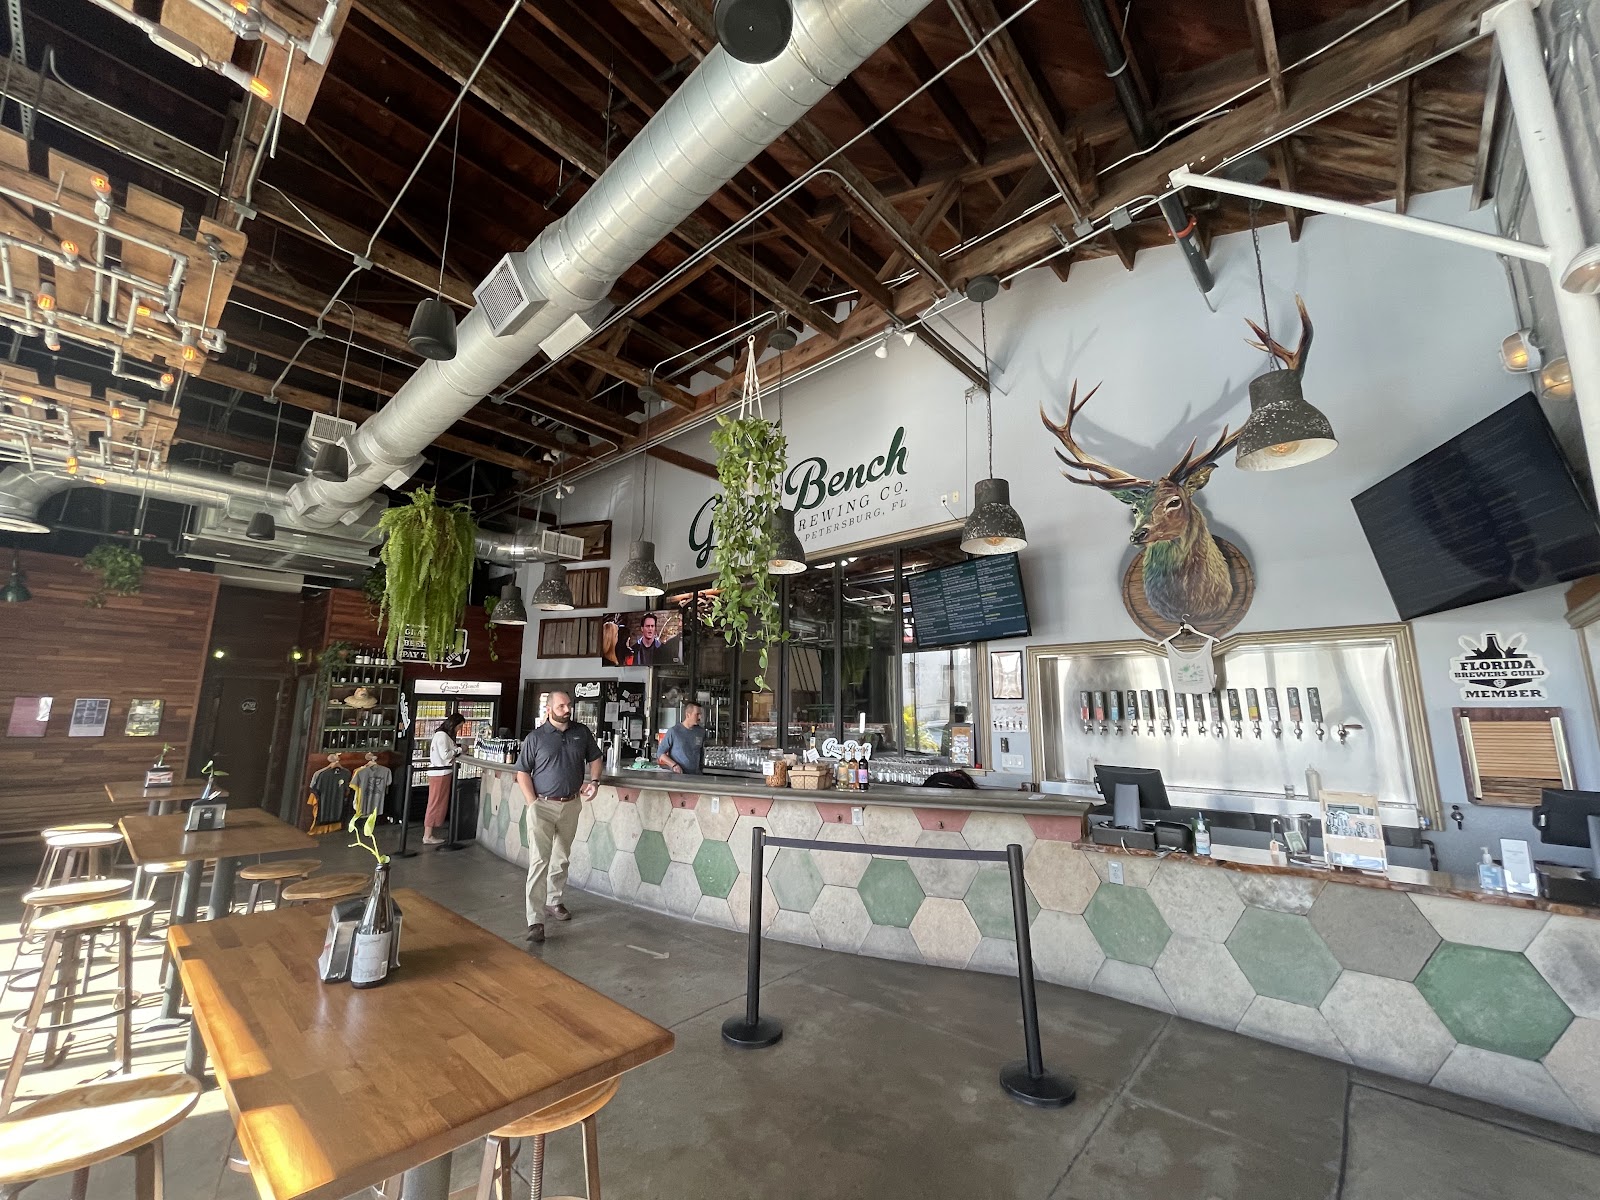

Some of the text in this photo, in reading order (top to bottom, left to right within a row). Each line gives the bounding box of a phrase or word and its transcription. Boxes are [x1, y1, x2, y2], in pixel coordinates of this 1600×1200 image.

[785, 426, 908, 512] Bench
[794, 494, 870, 532] REWING
[804, 499, 907, 542] PETERSBURG, FL
[403, 651, 420, 659] PAY
[1460, 660, 1536, 671] FLORIDA
[1511, 669, 1545, 677] GUILD
[1464, 689, 1546, 699] MEMBER
